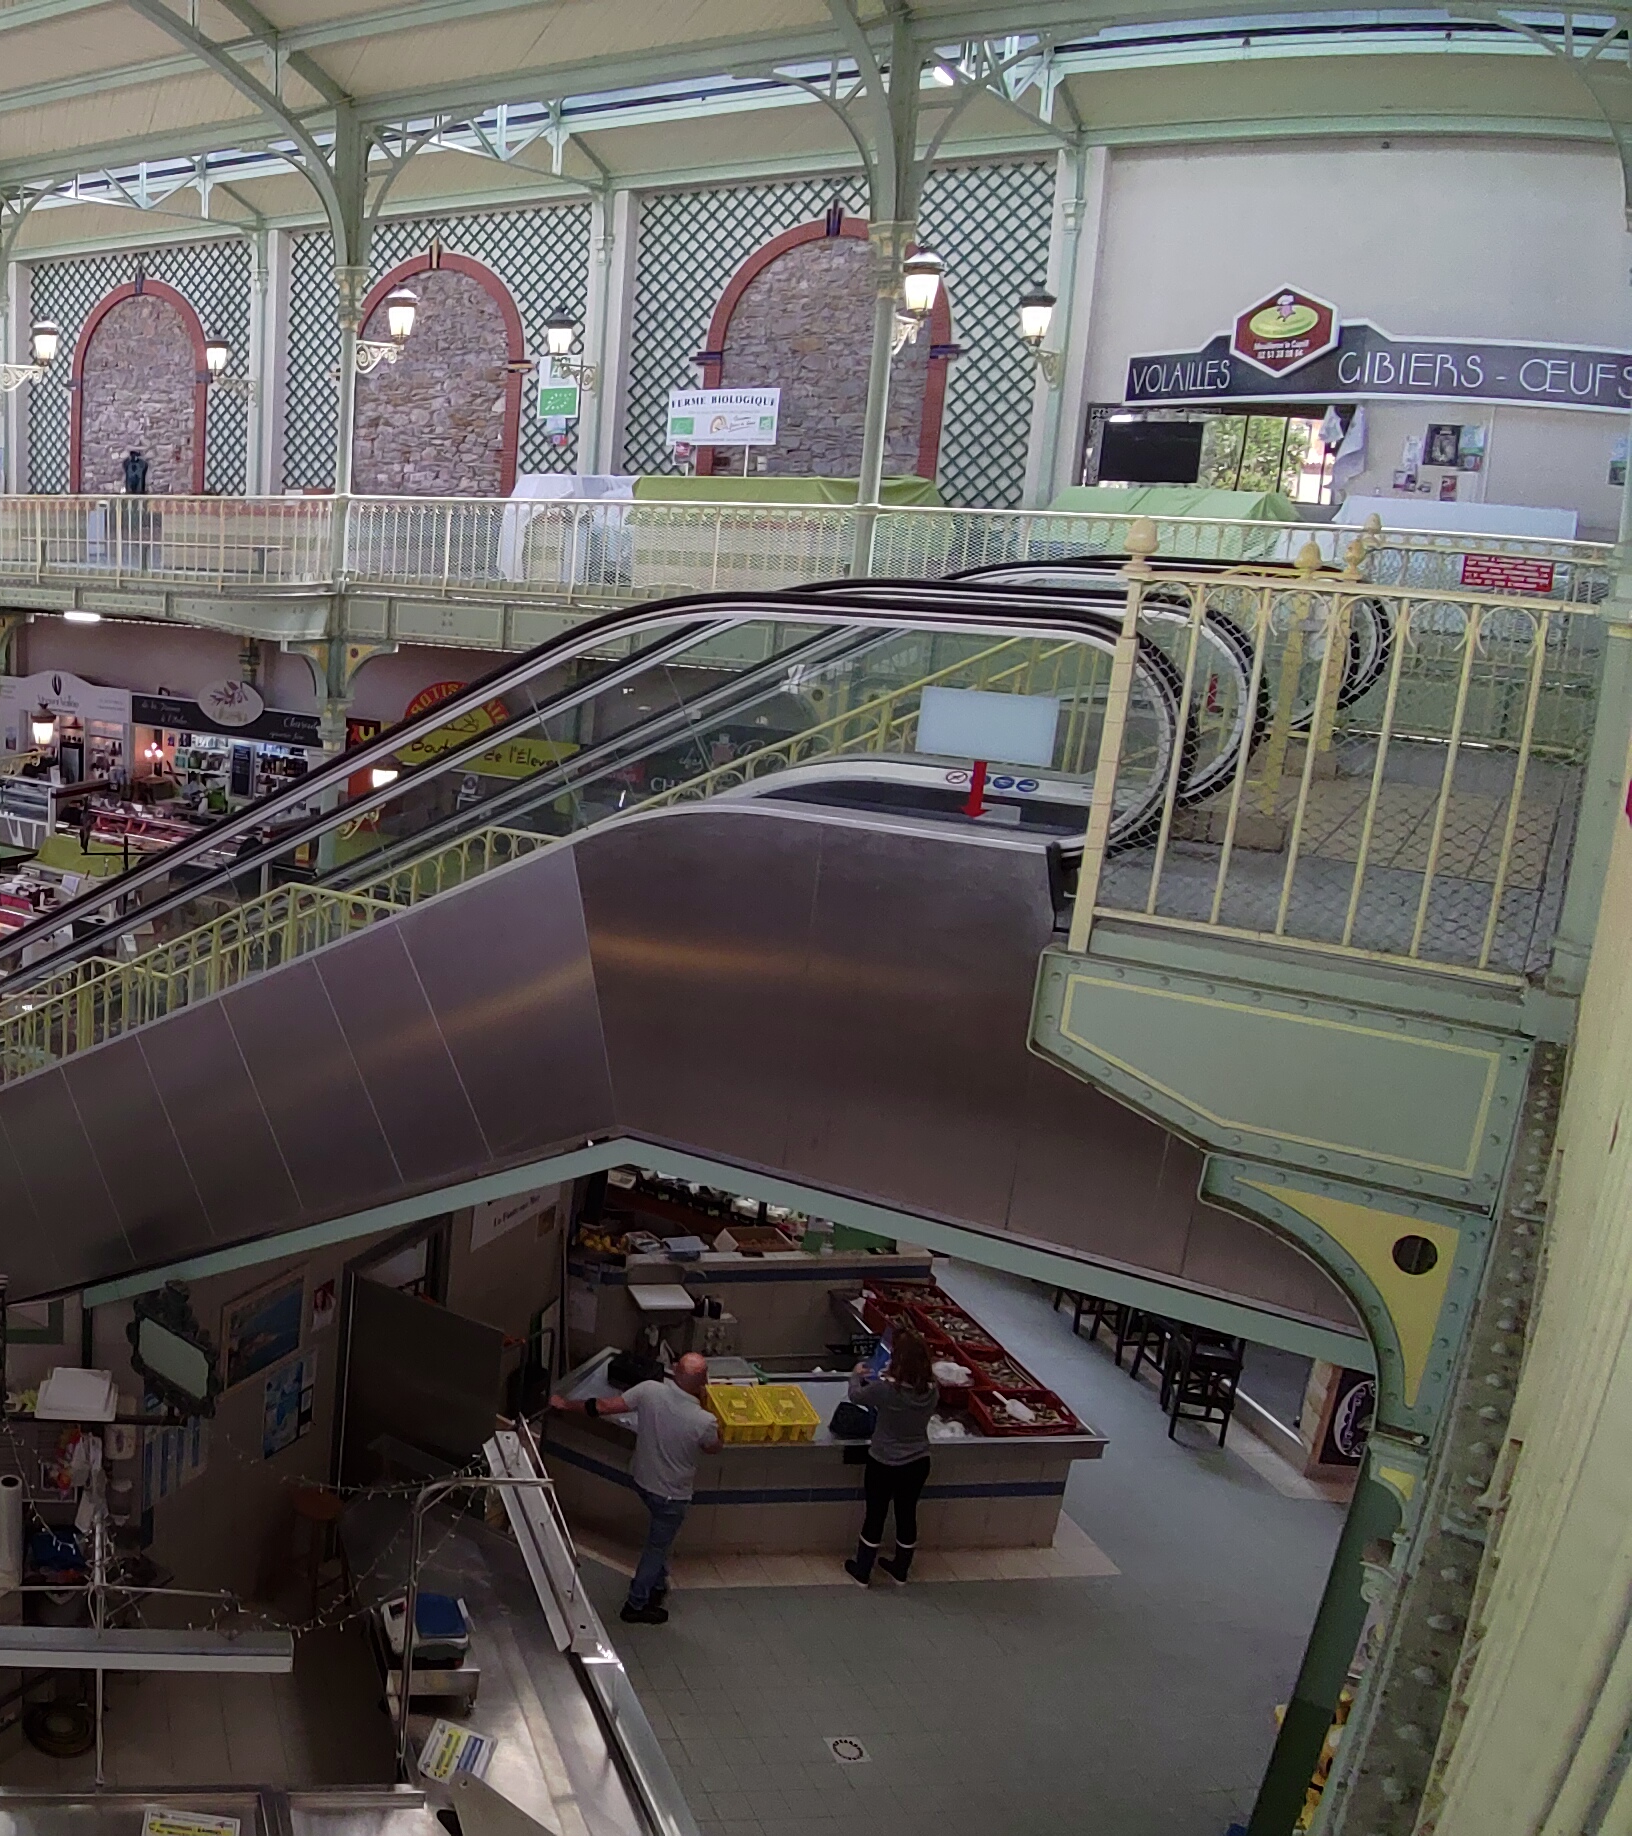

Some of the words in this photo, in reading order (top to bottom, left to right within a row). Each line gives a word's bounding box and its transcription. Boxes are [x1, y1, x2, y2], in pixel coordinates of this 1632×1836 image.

[1133, 359, 1231, 395] VOLAILLES
[1338, 351, 1484, 390] GIBIERS
[671, 396, 706, 408] FERME
[711, 394, 775, 406] BIOLOGIQUE
[484, 750, 502, 762] de
[509, 745, 558, 767] l'Éleve
